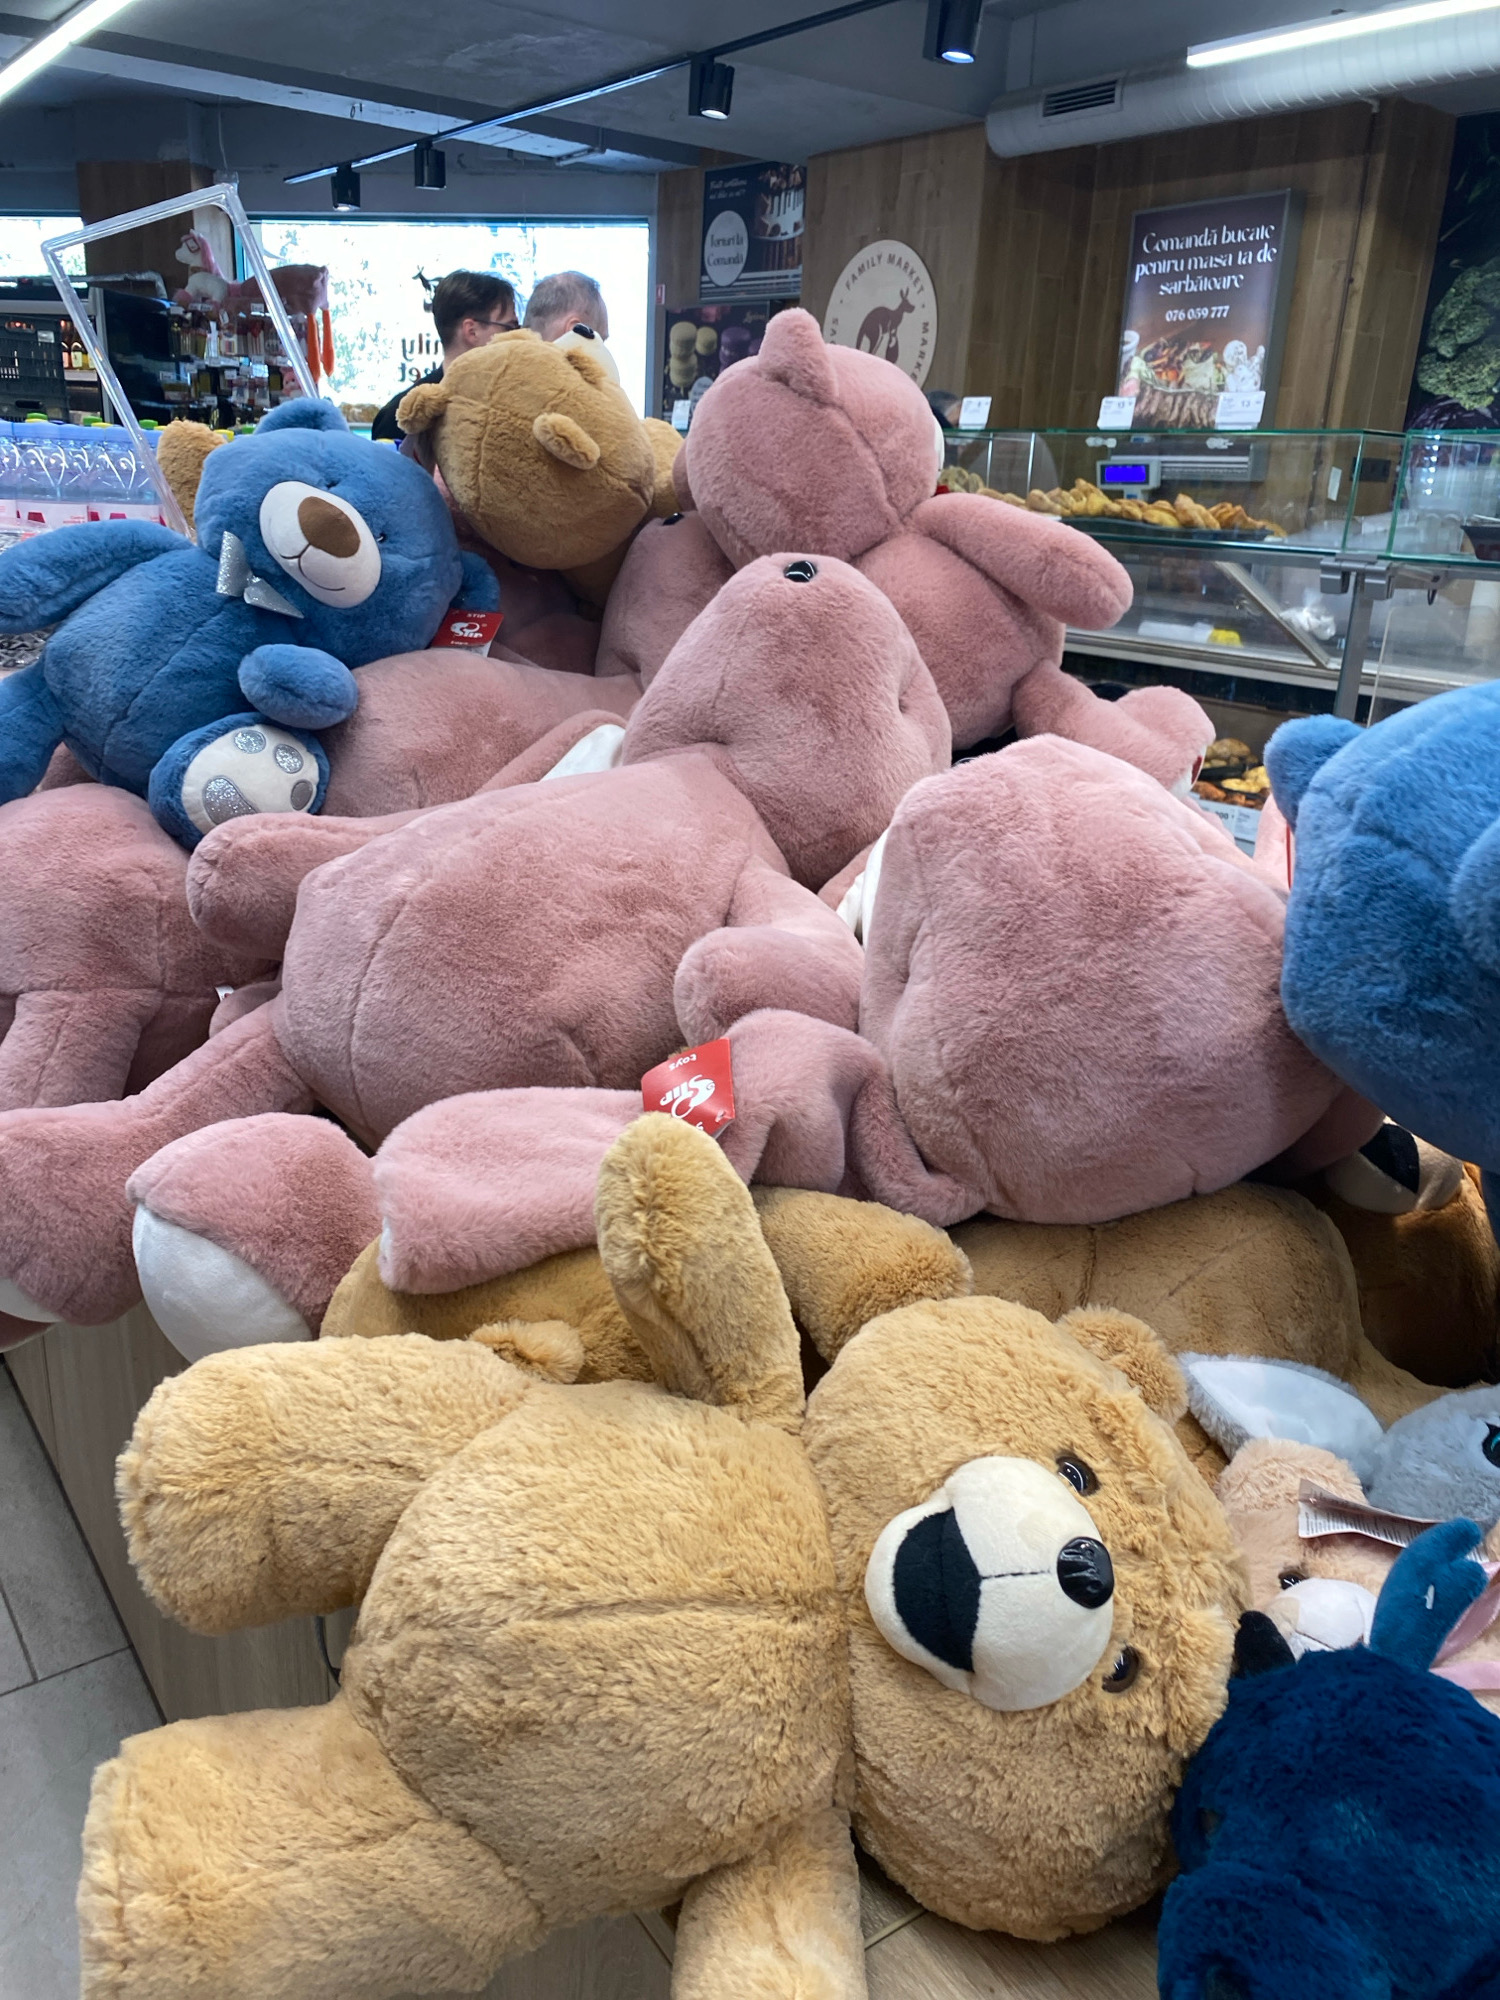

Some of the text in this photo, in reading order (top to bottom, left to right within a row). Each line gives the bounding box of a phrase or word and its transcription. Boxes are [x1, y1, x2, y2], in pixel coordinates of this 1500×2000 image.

[1142, 224, 1275, 253] Comandă bucate
[844, 252, 925, 295] FAMILY MARKET
[1134, 242, 1277, 283] pentru masa ta de
[1165, 309, 1186, 322] 076
[1210, 305, 1230, 319] 777
[910, 321, 930, 381] MARKE
[668, 1053, 697, 1071] toys
